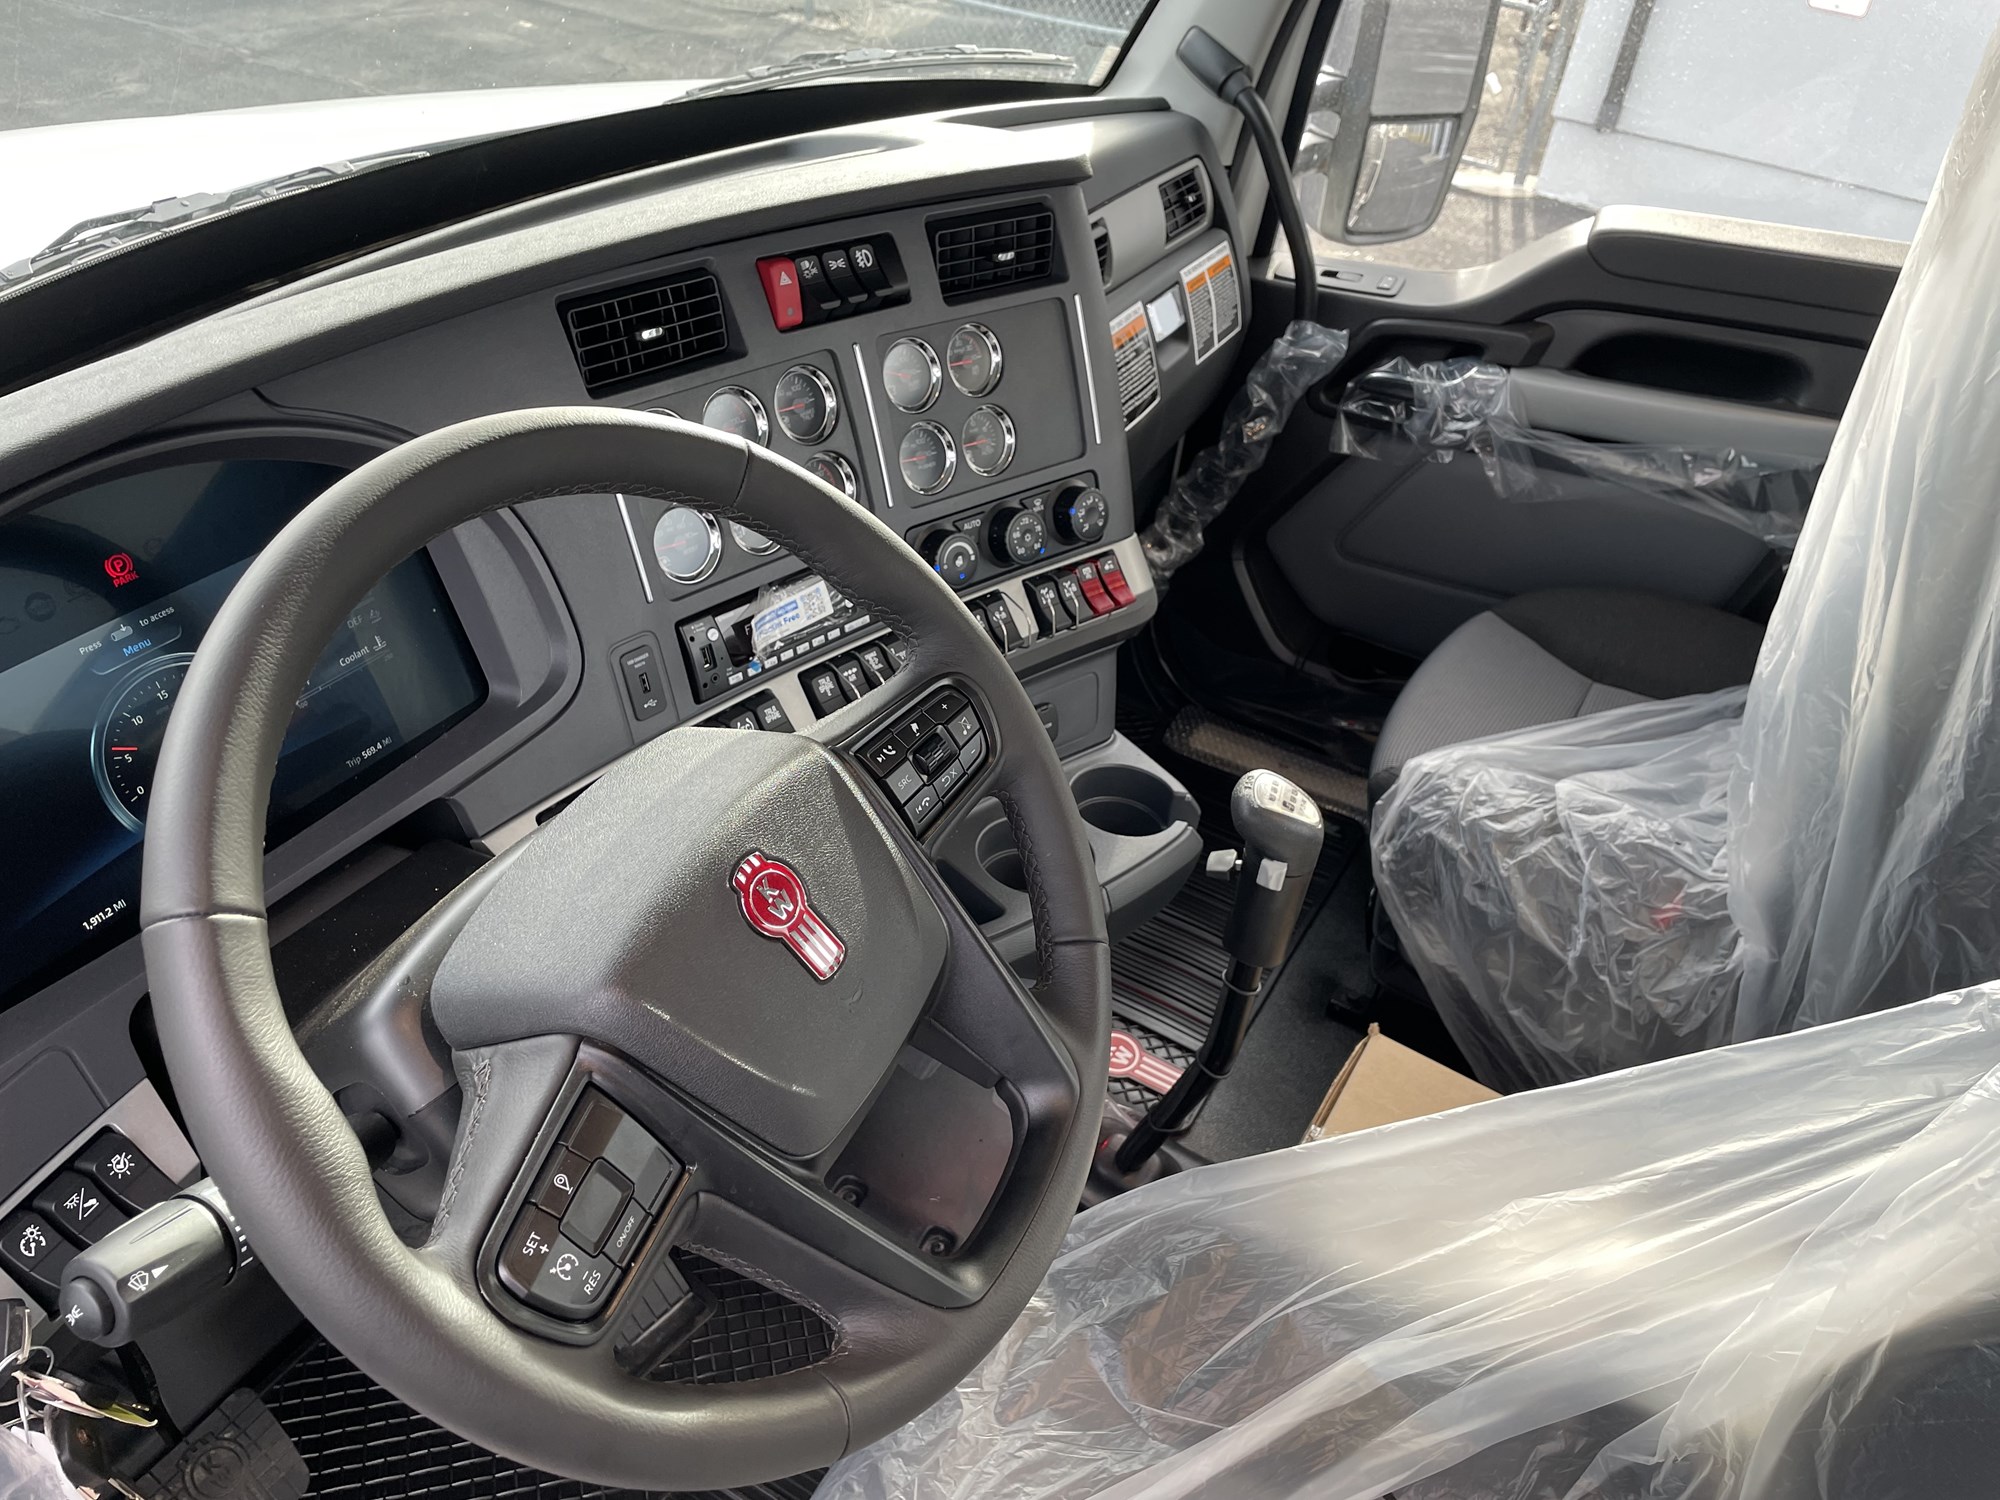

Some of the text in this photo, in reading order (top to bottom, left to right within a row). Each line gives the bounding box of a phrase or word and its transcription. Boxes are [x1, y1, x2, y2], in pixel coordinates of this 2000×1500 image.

[963, 518, 981, 531] AUTO
[113, 571, 140, 588] PARK
[79, 606, 175, 655] Press to access
[346, 615, 363, 629] DEF
[122, 638, 152, 657] Menu
[340, 646, 370, 667] Coolant
[156, 689, 169, 701] 15
[131, 715, 144, 726] 10
[124, 753, 133, 763] 5
[345, 736, 393, 768] Trip 569.4 MI
[136, 785, 145, 795] 0
[897, 774, 913, 790] SRC
[82, 898, 127, 930] 1,911.2 MI
[616, 1215, 636, 1248] ON/OFF
[522, 1232, 542, 1257] SET
[583, 1269, 602, 1295] RES
